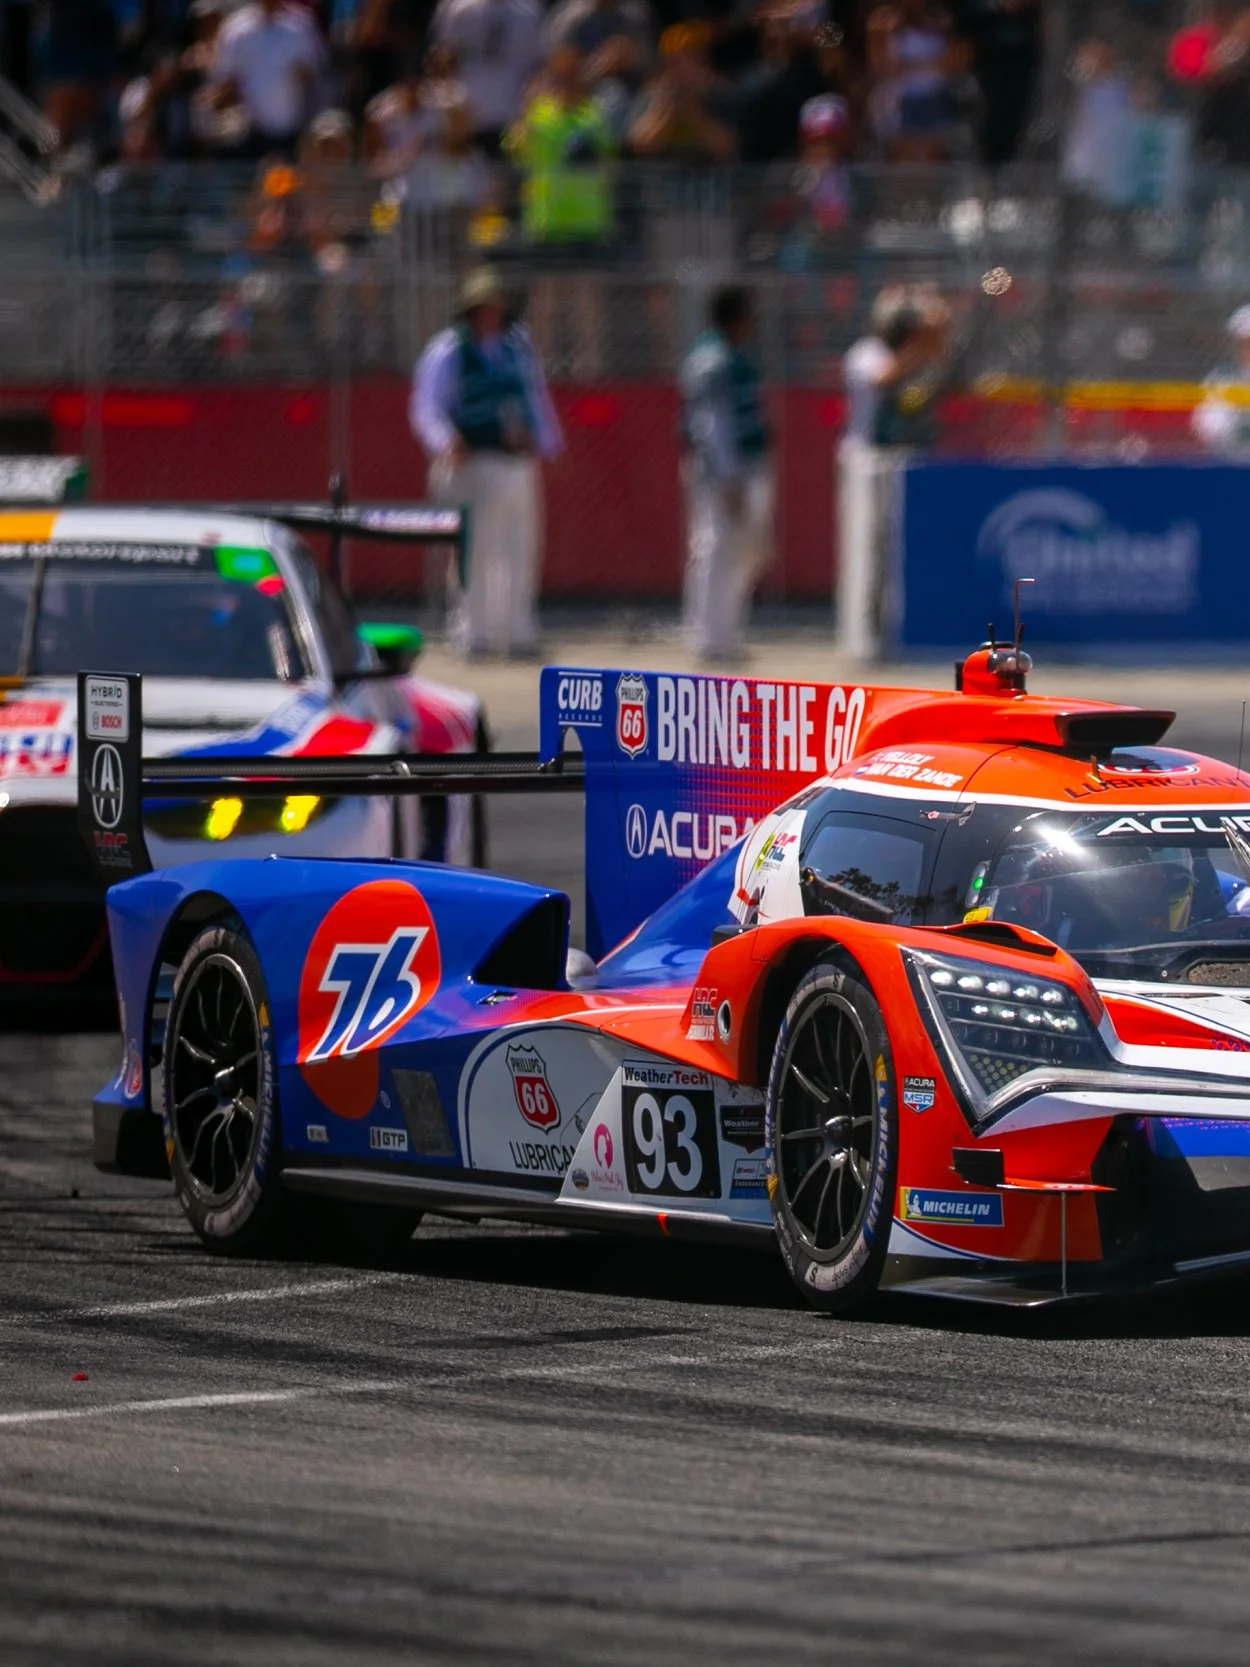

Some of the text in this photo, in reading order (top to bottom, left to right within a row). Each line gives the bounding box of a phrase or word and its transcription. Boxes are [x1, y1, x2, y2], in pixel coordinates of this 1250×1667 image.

[558, 678, 603, 711] CURB
[622, 709, 643, 739] 66
[657, 676, 866, 774] BRING THE GO
[306, 926, 431, 1063] 76
[510, 1056, 542, 1074] PHILLIPS
[624, 1066, 709, 1086] WeatherTech
[908, 1077, 935, 1087] ACURA
[521, 1082, 549, 1115] 66
[904, 1094, 933, 1103] MSR
[383, 1132, 405, 1147] GTP
[633, 1092, 703, 1192] 93
[509, 1140, 577, 1176] LUBRICA
[923, 1200, 990, 1216] MICHELIN
